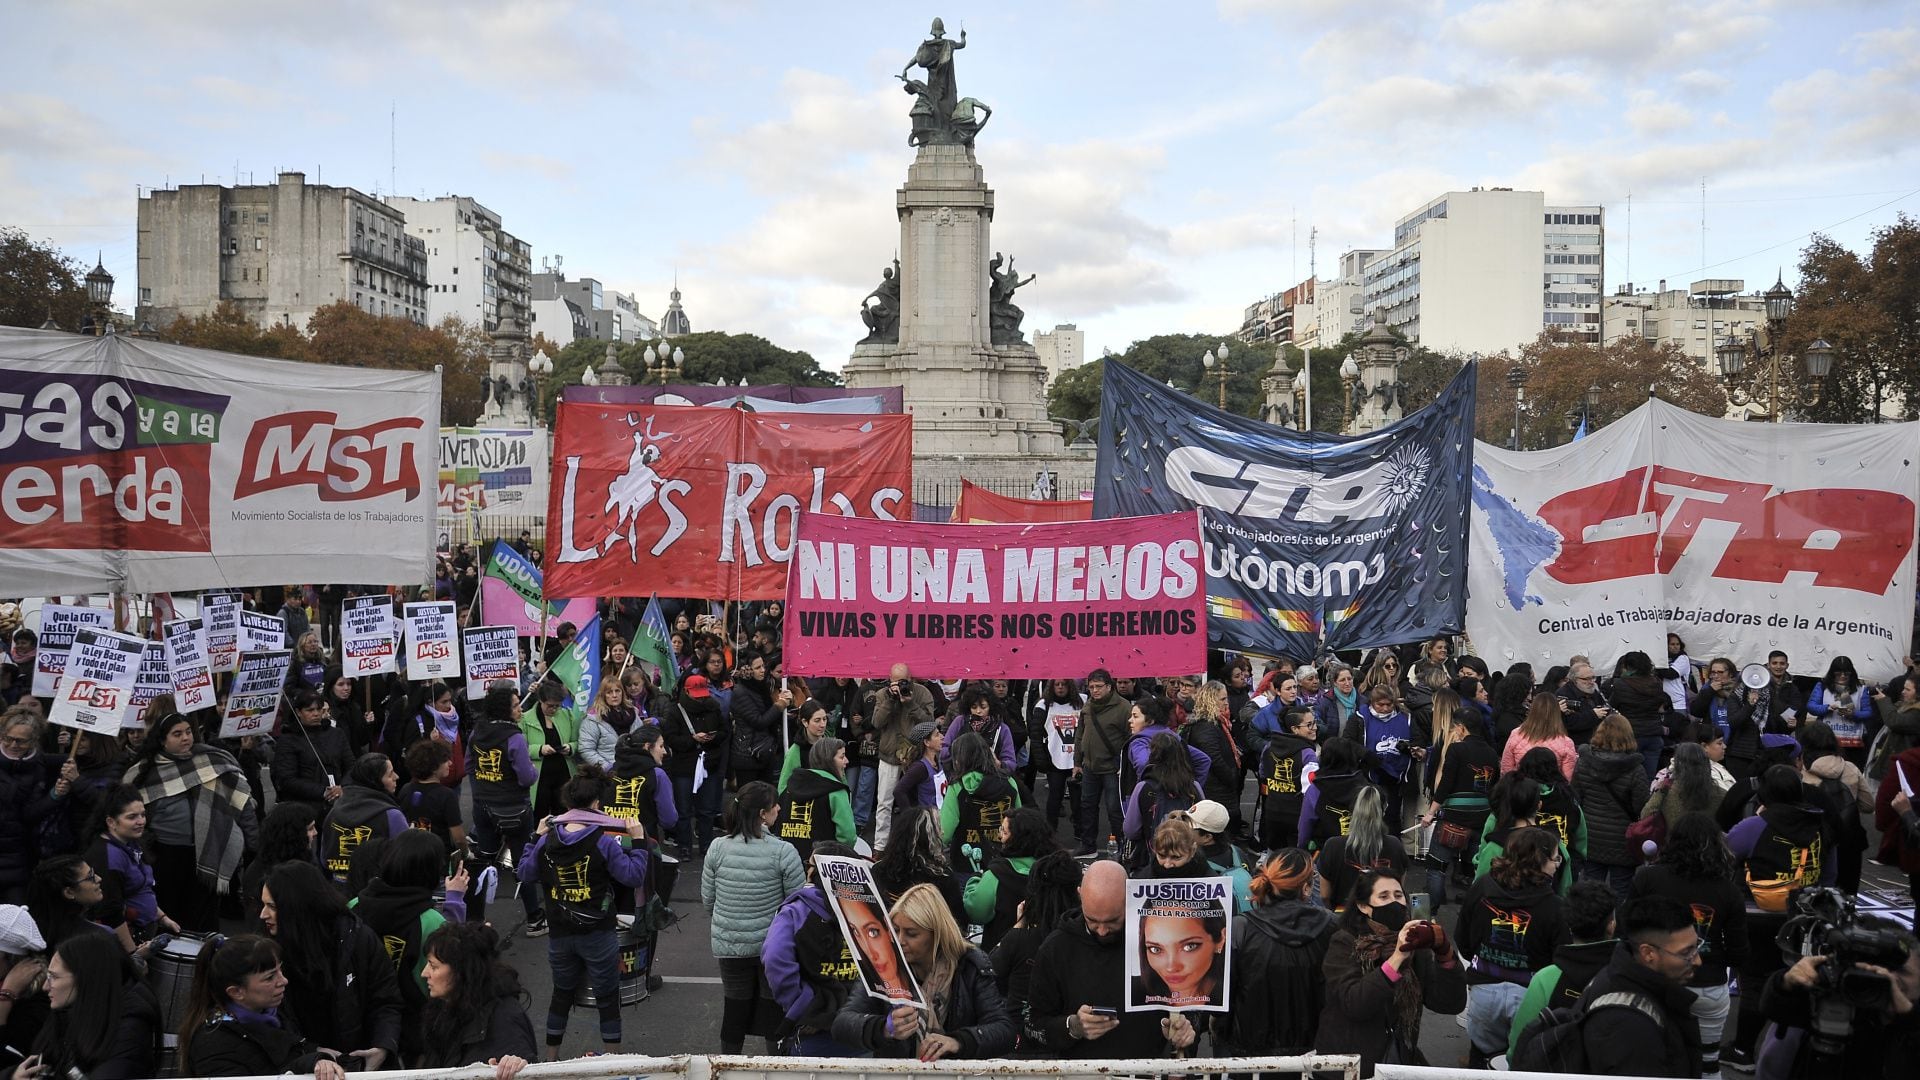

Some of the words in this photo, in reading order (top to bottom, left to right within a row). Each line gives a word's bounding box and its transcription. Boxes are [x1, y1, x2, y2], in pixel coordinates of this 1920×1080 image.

[139, 407, 153, 434] y
[162, 410, 180, 436] a
[190, 412, 216, 438] la
[250, 420, 416, 495] MST
[439, 436, 526, 469] IVERSIDAD
[0, 456, 183, 526] erda
[1165, 447, 1388, 523] CTA
[231, 511, 285, 522] Movimiento
[287, 510, 331, 521] Socialista
[333, 511, 345, 521] de
[348, 511, 362, 521] los
[365, 511, 424, 524] Trabajadores
[1210, 520, 1223, 533] de
[1315, 534, 1329, 546] de
[1331, 535, 1341, 545] la
[1537, 464, 1915, 596] CTA
[798, 540, 857, 601] NI
[869, 545, 991, 603] UNA
[1002, 539, 1200, 603] MENOS
[53, 612, 70, 623] Que
[70, 613, 79, 622] la
[80, 613, 95, 623] CGT
[96, 615, 101, 625] y
[416, 607, 440, 617] JUSTICIA
[44, 623, 58, 632] las
[58, 623, 77, 633] CTAs
[414, 618, 424, 626] por
[800, 612, 877, 638] VIVAS
[883, 613, 900, 638] Y
[905, 613, 995, 639] LIBRES
[1001, 613, 1054, 639] NOS
[1059, 609, 1197, 641] QUEREMOS
[1538, 613, 1595, 635] Central
[1597, 612, 1615, 627] de
[1767, 613, 1789, 628] de
[1793, 614, 1810, 630] la
[1814, 616, 1894, 641] Argentina
[41, 635, 48, 644] A
[49, 636, 71, 645] PARO
[93, 636, 121, 650] ABAJO
[423, 632, 447, 640] Barracas
[465, 634, 485, 643] TODO
[485, 632, 493, 641] EL
[493, 630, 515, 640] APOYO
[419, 643, 449, 658] MST
[475, 643, 484, 651] AL
[484, 640, 509, 650] PUEBLO
[81, 645, 89, 656] la
[89, 647, 102, 659] Ley
[103, 649, 127, 662] Bases
[473, 653, 482, 661] DE
[482, 649, 514, 660] MISIONES
[75, 657, 81, 666] y
[81, 658, 99, 668] todo
[99, 660, 108, 670] el
[107, 661, 127, 673] plan
[149, 663, 168, 672] PUE
[359, 658, 381, 670] MST
[83, 668, 92, 678] de
[93, 670, 114, 682] Milei
[72, 683, 120, 707] MST
[820, 861, 871, 884] JUSTICIA
[1132, 883, 1226, 901] JUSTICIA
[1151, 900, 1179, 908] TODOS
[1179, 901, 1210, 910] SOMOS
[1137, 908, 1173, 918] MICAELA
[1175, 910, 1223, 919] RASCOVSKY
